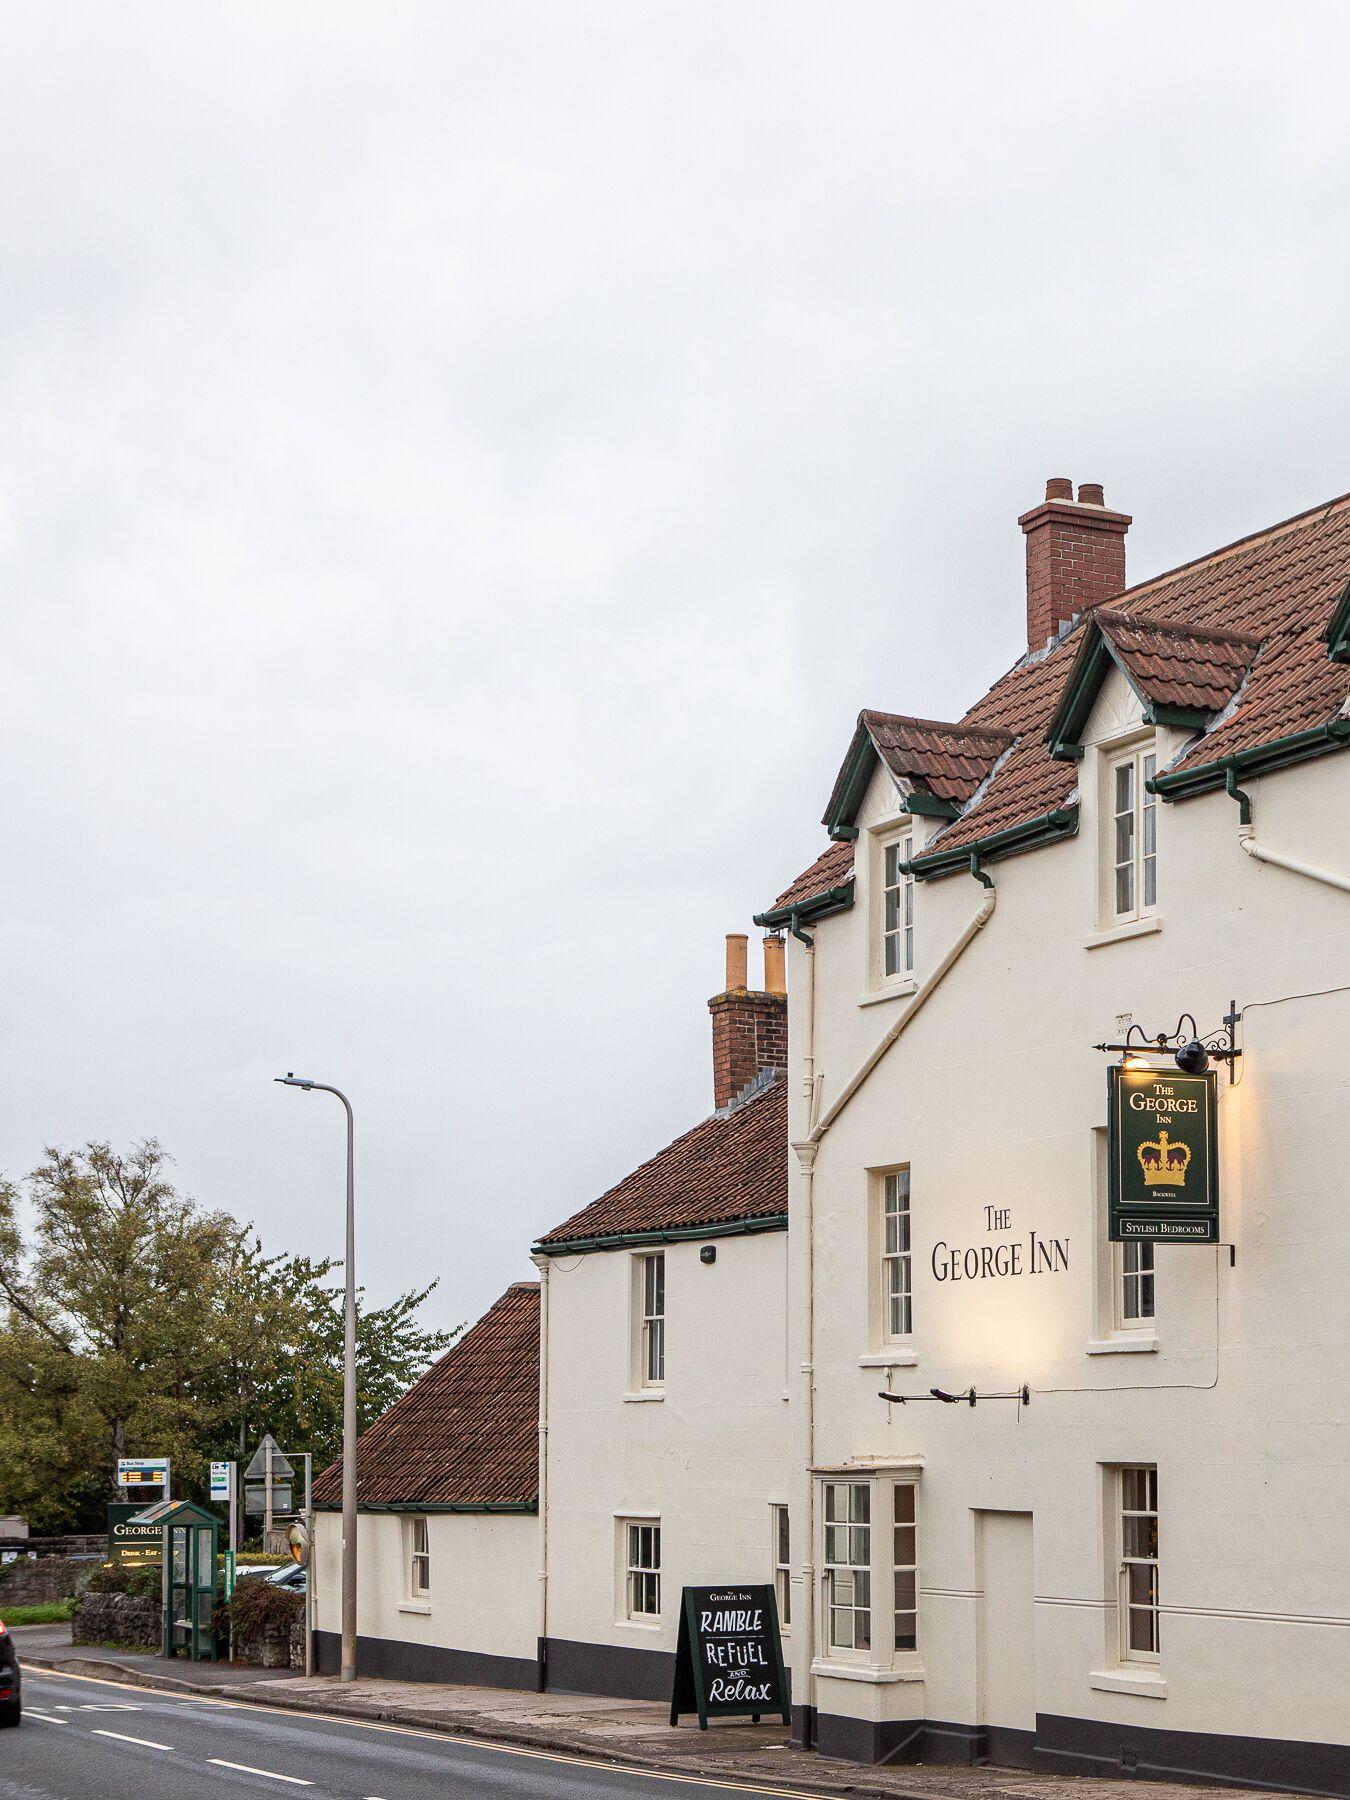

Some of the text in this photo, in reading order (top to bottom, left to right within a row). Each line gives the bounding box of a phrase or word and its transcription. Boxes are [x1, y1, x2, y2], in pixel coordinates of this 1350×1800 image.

[1153, 1083, 1174, 1096] THE
[1129, 1092, 1198, 1113] GEORGE
[1156, 1113, 1172, 1124] INN
[983, 1205, 1012, 1232] THE
[1126, 1222, 1205, 1234] STYLISH BEDROOMS
[931, 1231, 1070, 1282] GEORGE INN
[113, 1523, 163, 1536] GEORGE
[709, 1593, 738, 1602] GEORGE
[700, 1609, 762, 1633] RAMBLE
[706, 1641, 768, 1667] REFUEL
[729, 1670, 747, 1678] AND
[709, 1678, 772, 1702] Relax
